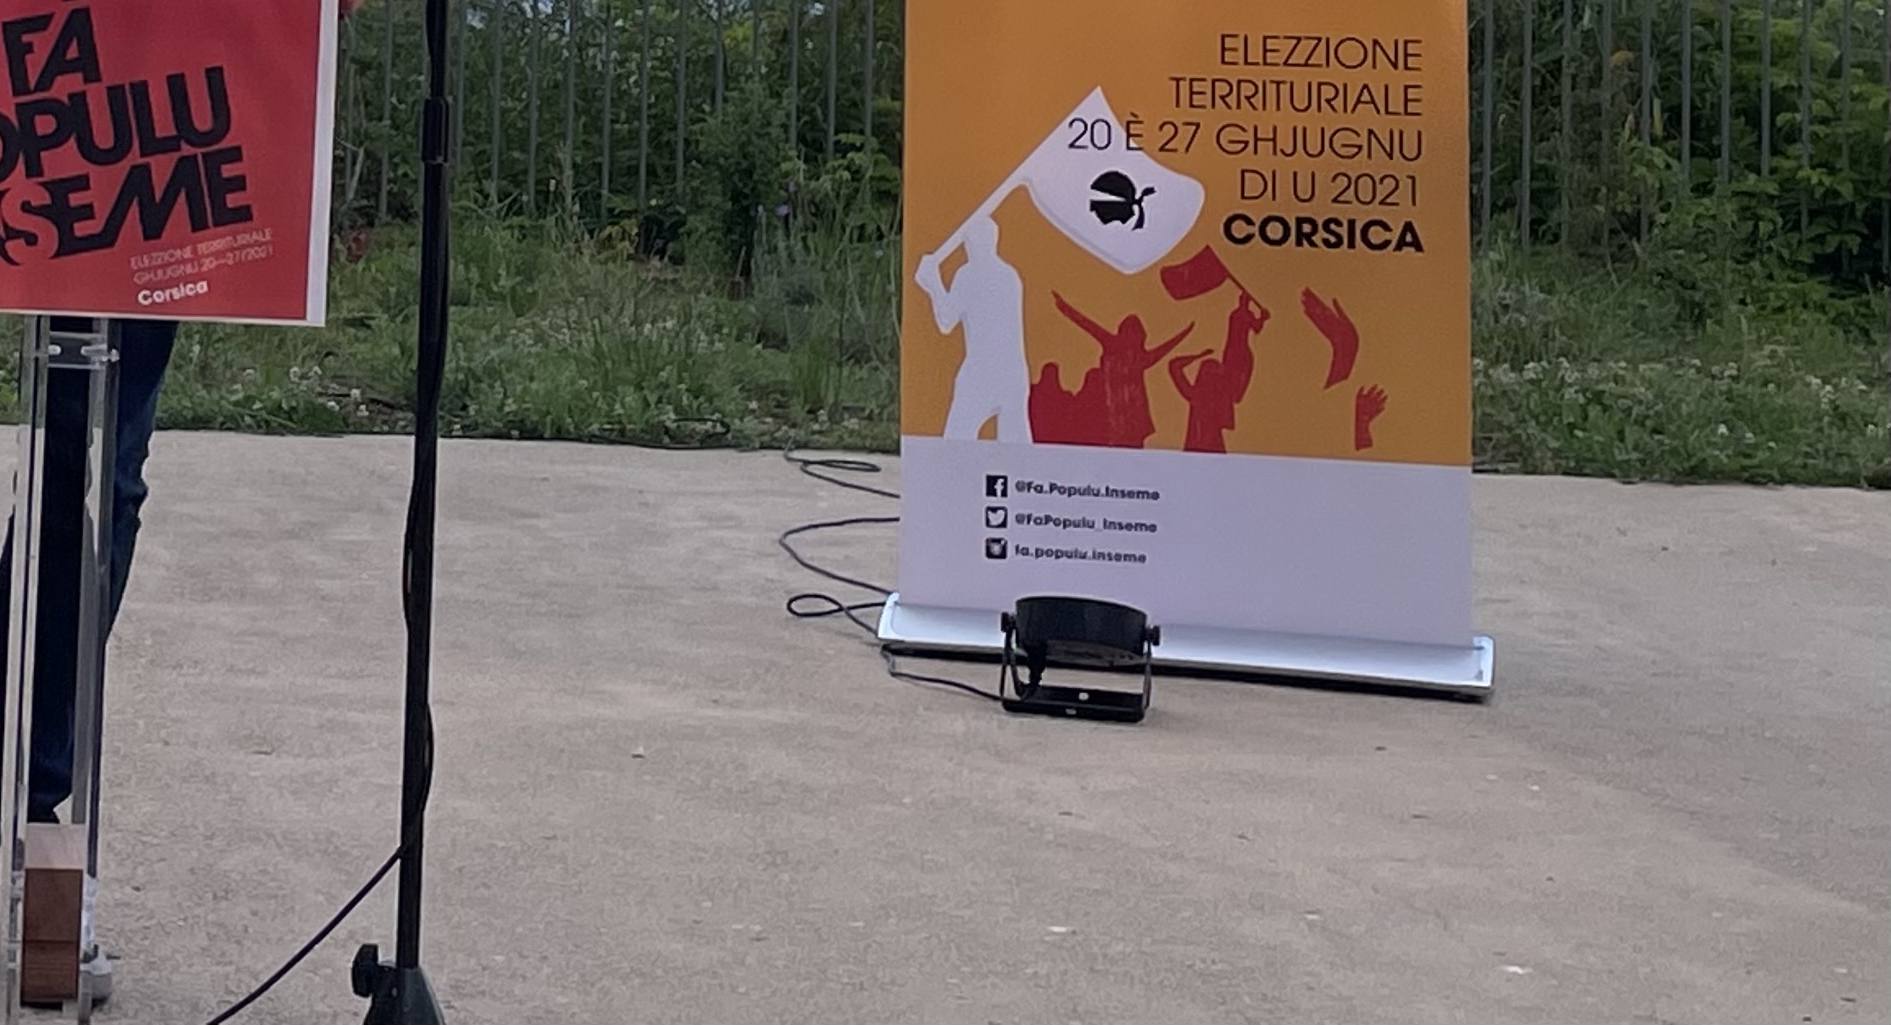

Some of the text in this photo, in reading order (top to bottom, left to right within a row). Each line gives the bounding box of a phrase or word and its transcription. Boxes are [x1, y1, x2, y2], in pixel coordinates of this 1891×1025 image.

[1219, 33, 1423, 71] ELEZZIONE
[1169, 76, 1423, 116] TERRITURIALE
[1068, 111, 1423, 161] 20 È 27 GHJUGNU
[1240, 169, 1418, 207] DI U 2021
[1223, 213, 1425, 254] CORSICA
[137, 280, 209, 305] Corsica
